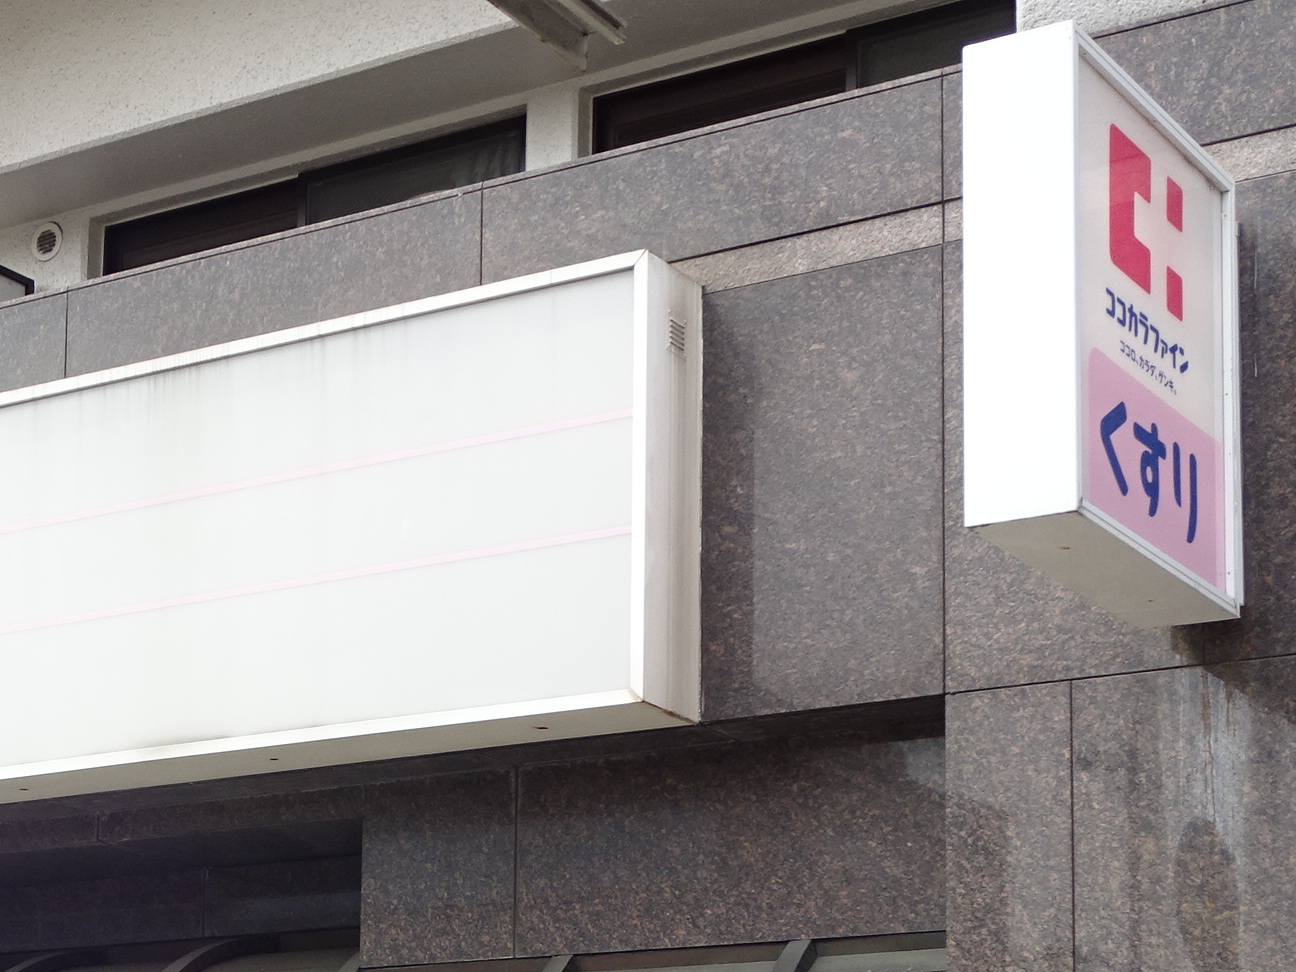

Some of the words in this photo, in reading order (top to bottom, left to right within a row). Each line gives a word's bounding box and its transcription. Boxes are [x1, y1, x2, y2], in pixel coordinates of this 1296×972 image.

[1105, 287, 1190, 376] ココカラファイン
[1100, 401, 1198, 544] くすり
